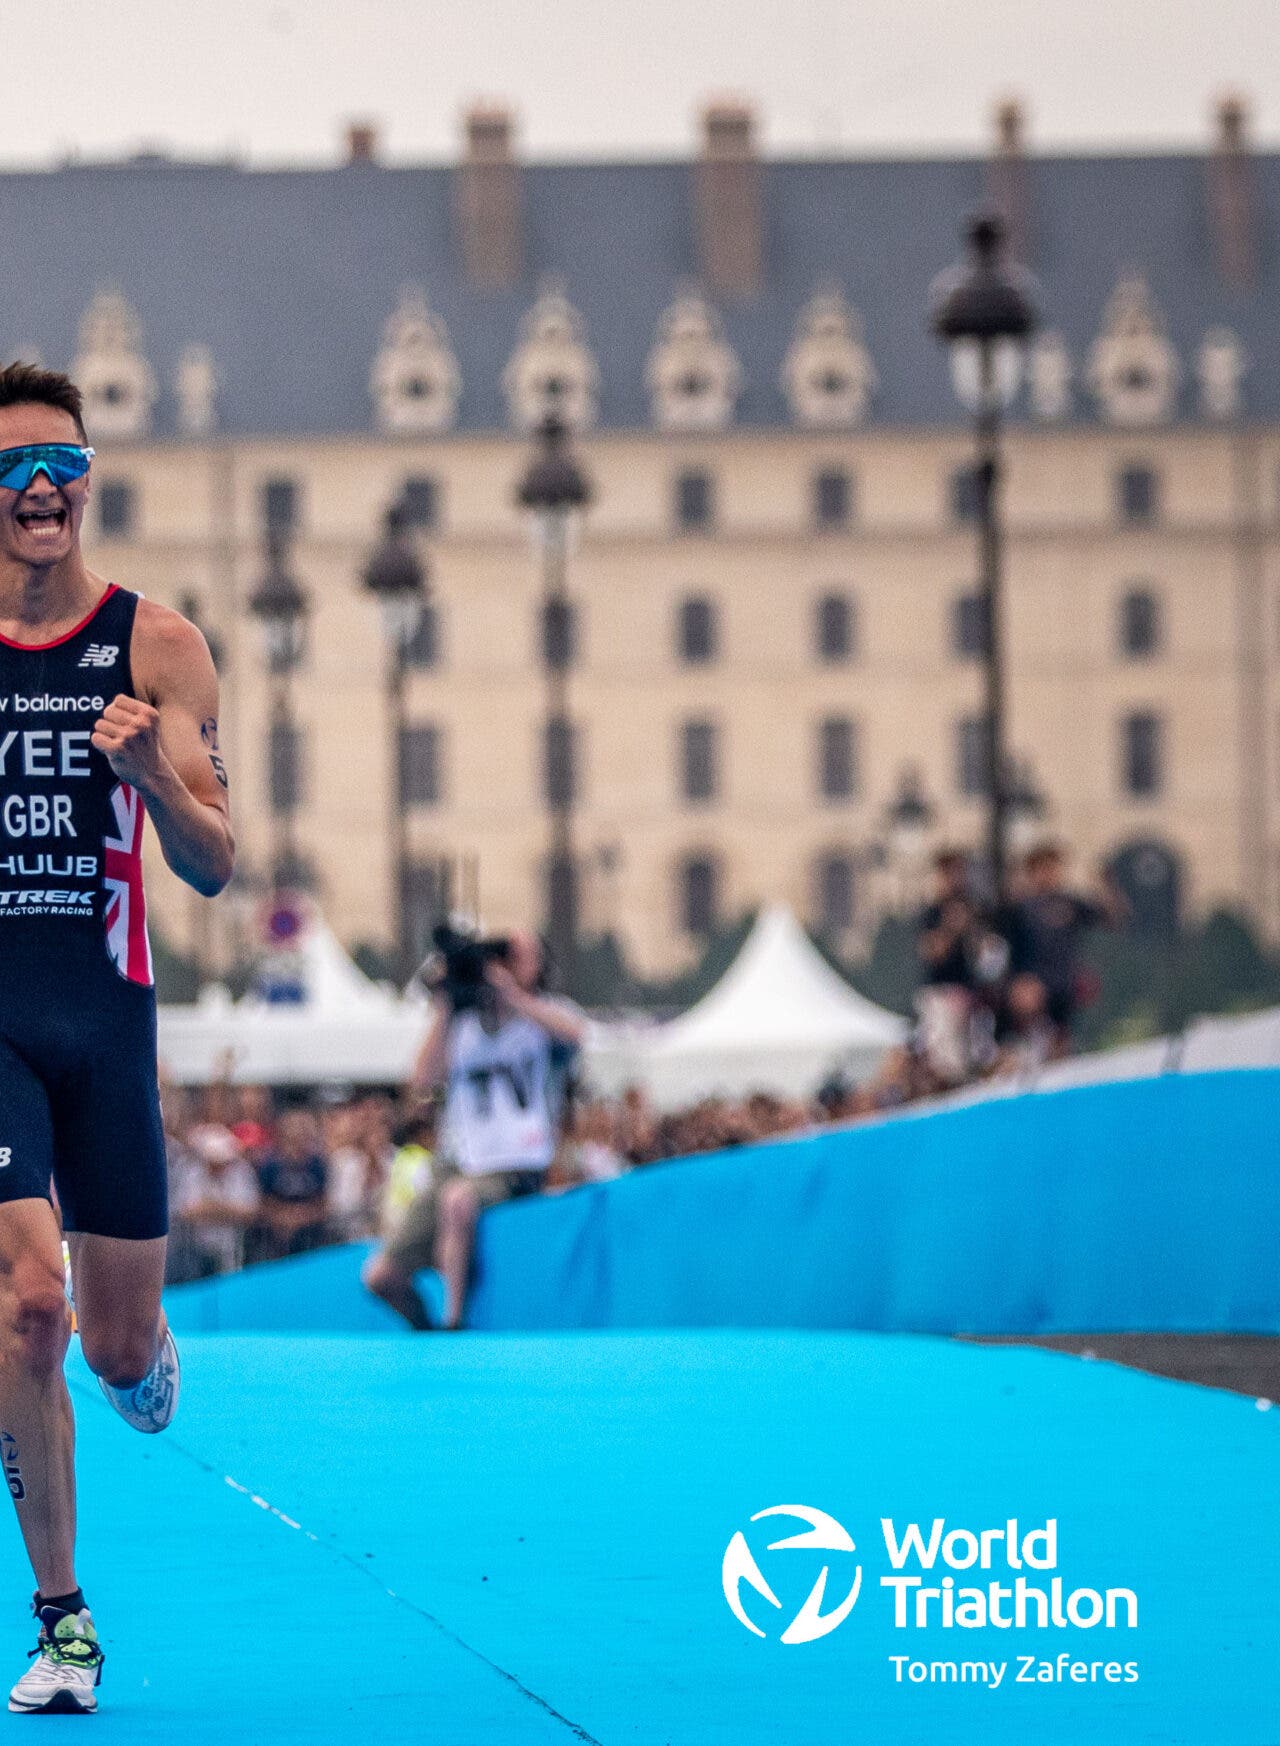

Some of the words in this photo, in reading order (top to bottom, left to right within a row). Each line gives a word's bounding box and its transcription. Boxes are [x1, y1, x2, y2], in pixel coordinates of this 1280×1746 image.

[77, 643, 120, 667] NB
[14, 693, 105, 713] balance
[3, 794, 78, 838] GBR
[0, 906, 49, 916] FACTORY
[50, 906, 94, 916] RACING
